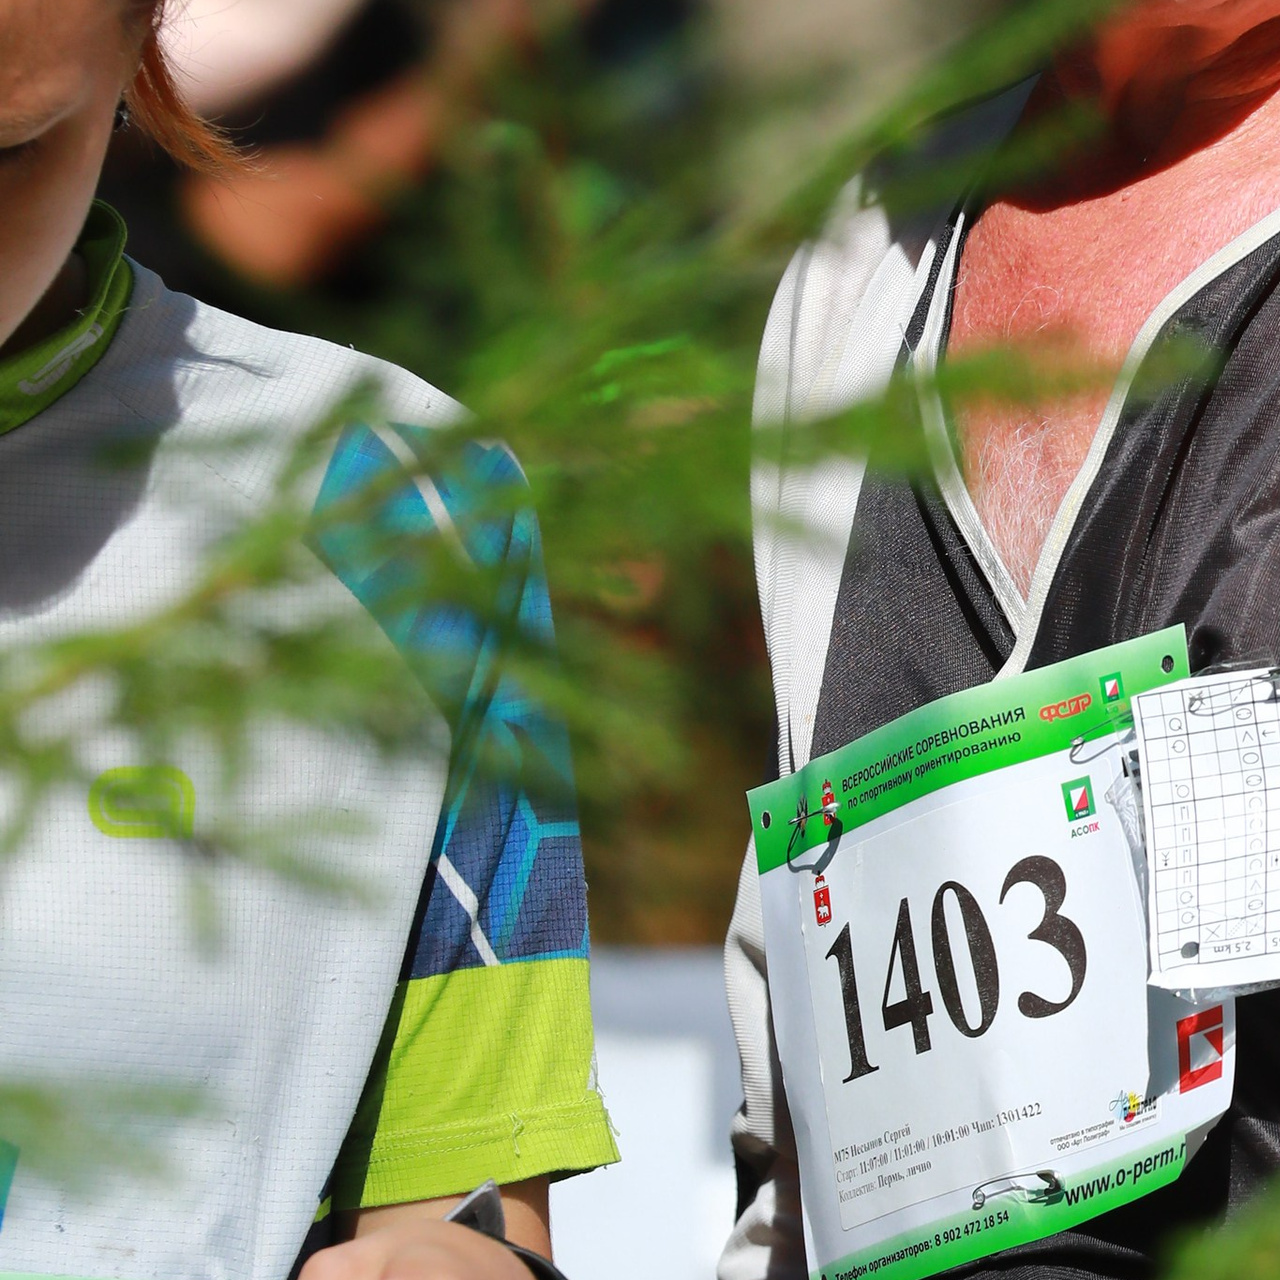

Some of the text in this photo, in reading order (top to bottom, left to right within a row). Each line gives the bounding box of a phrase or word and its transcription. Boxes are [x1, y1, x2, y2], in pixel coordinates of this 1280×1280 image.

[842, 707, 1026, 793] ВСЕРОССИЙСКИЕ СОРЕВНОВАНИЯ
[847, 731, 1021, 809] по спортивному ориентированию
[1071, 822, 1100, 839] АСОПК
[825, 855, 1089, 1085] 1403
[1213, 941, 1251, 953] 2,5 km
[884, 1123, 911, 1144] Сергей
[894, 1138, 926, 1161] 11:01:00
[932, 1124, 970, 1147] 10:01:00
[971, 1119, 995, 1134] Чип:
[996, 1102, 1042, 1126] 1301422
[906, 1161, 932, 1177] лично
[869, 1239, 932, 1273] организаторов:
[934, 1234, 942, 1247] 8
[943, 1227, 962, 1244] 902
[964, 1220, 981, 1236] 472
[983, 1215, 995, 1229] 18
[997, 1210, 1010, 1224] 54
